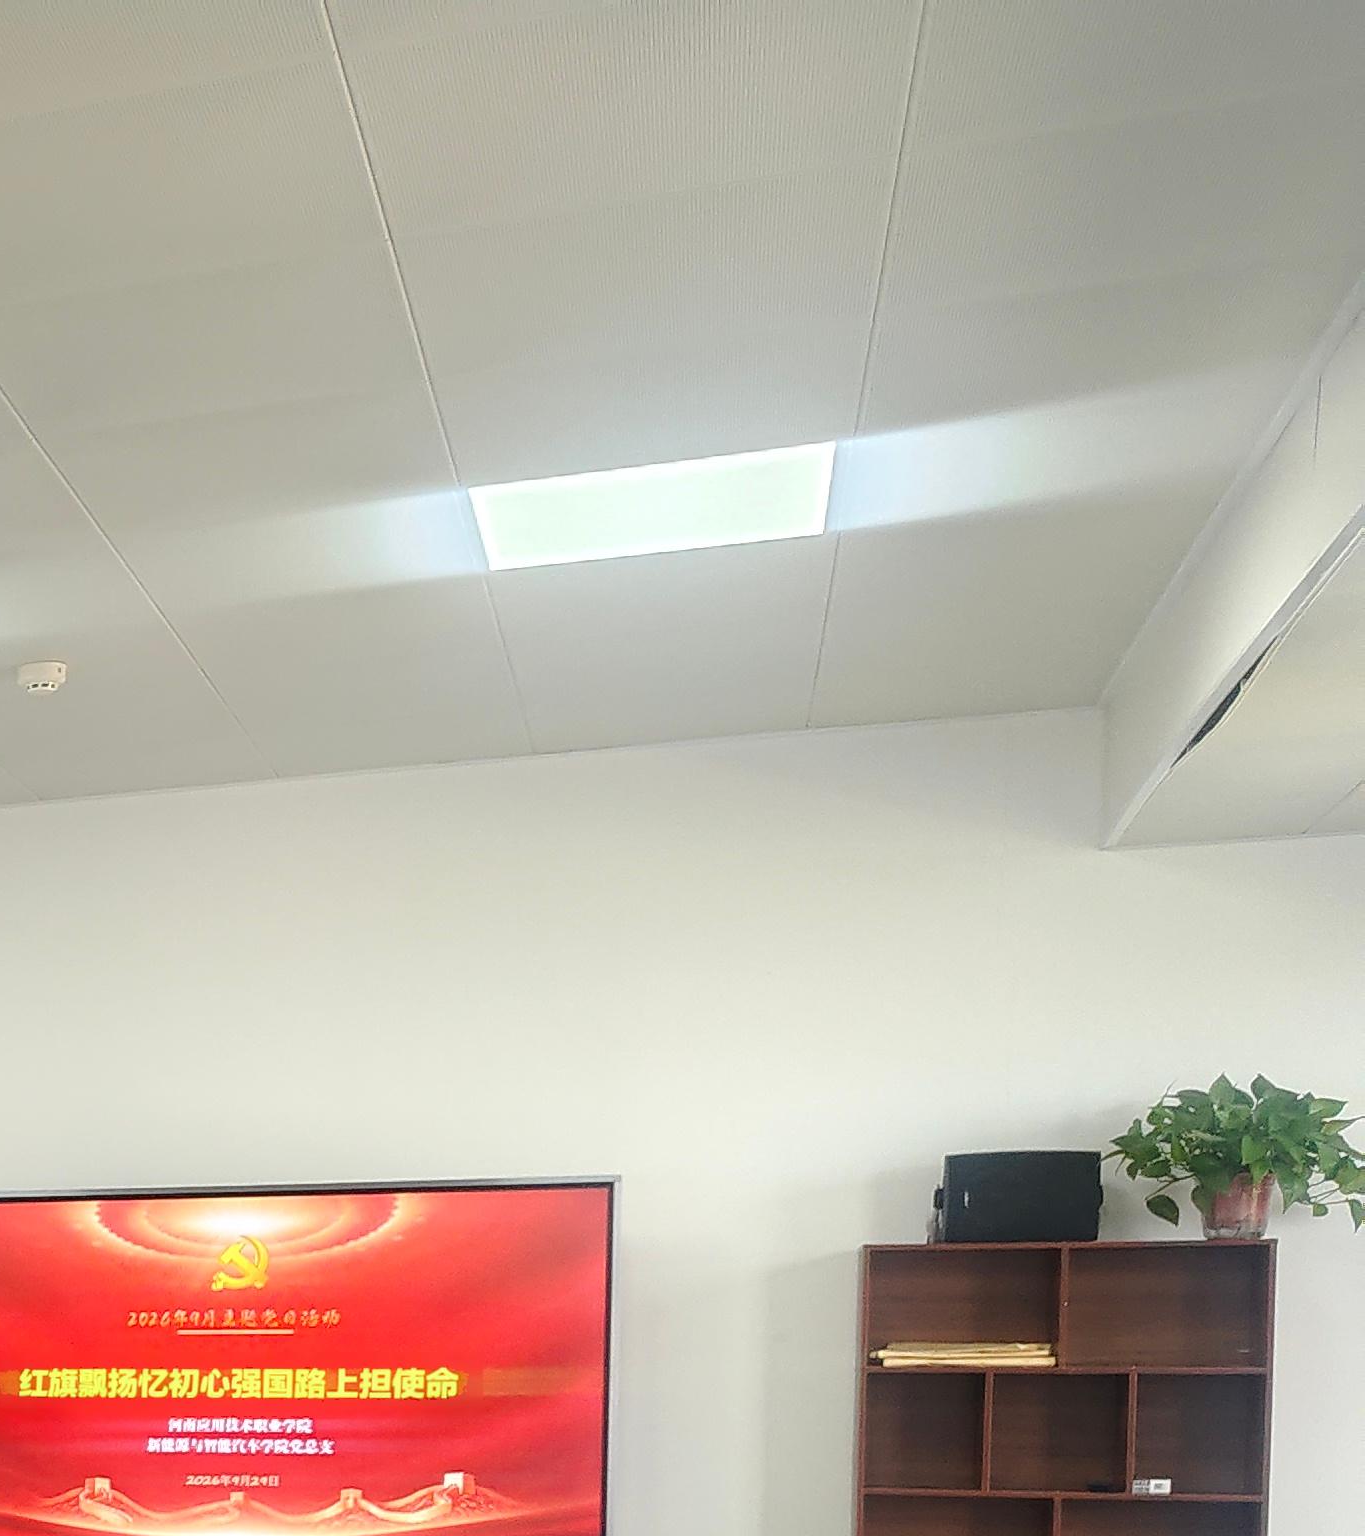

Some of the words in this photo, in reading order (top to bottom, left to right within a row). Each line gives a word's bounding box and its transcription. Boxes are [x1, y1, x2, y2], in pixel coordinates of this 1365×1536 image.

[19, 1366, 460, 1402] 红旗飘扬忆初心强国路上担使命
